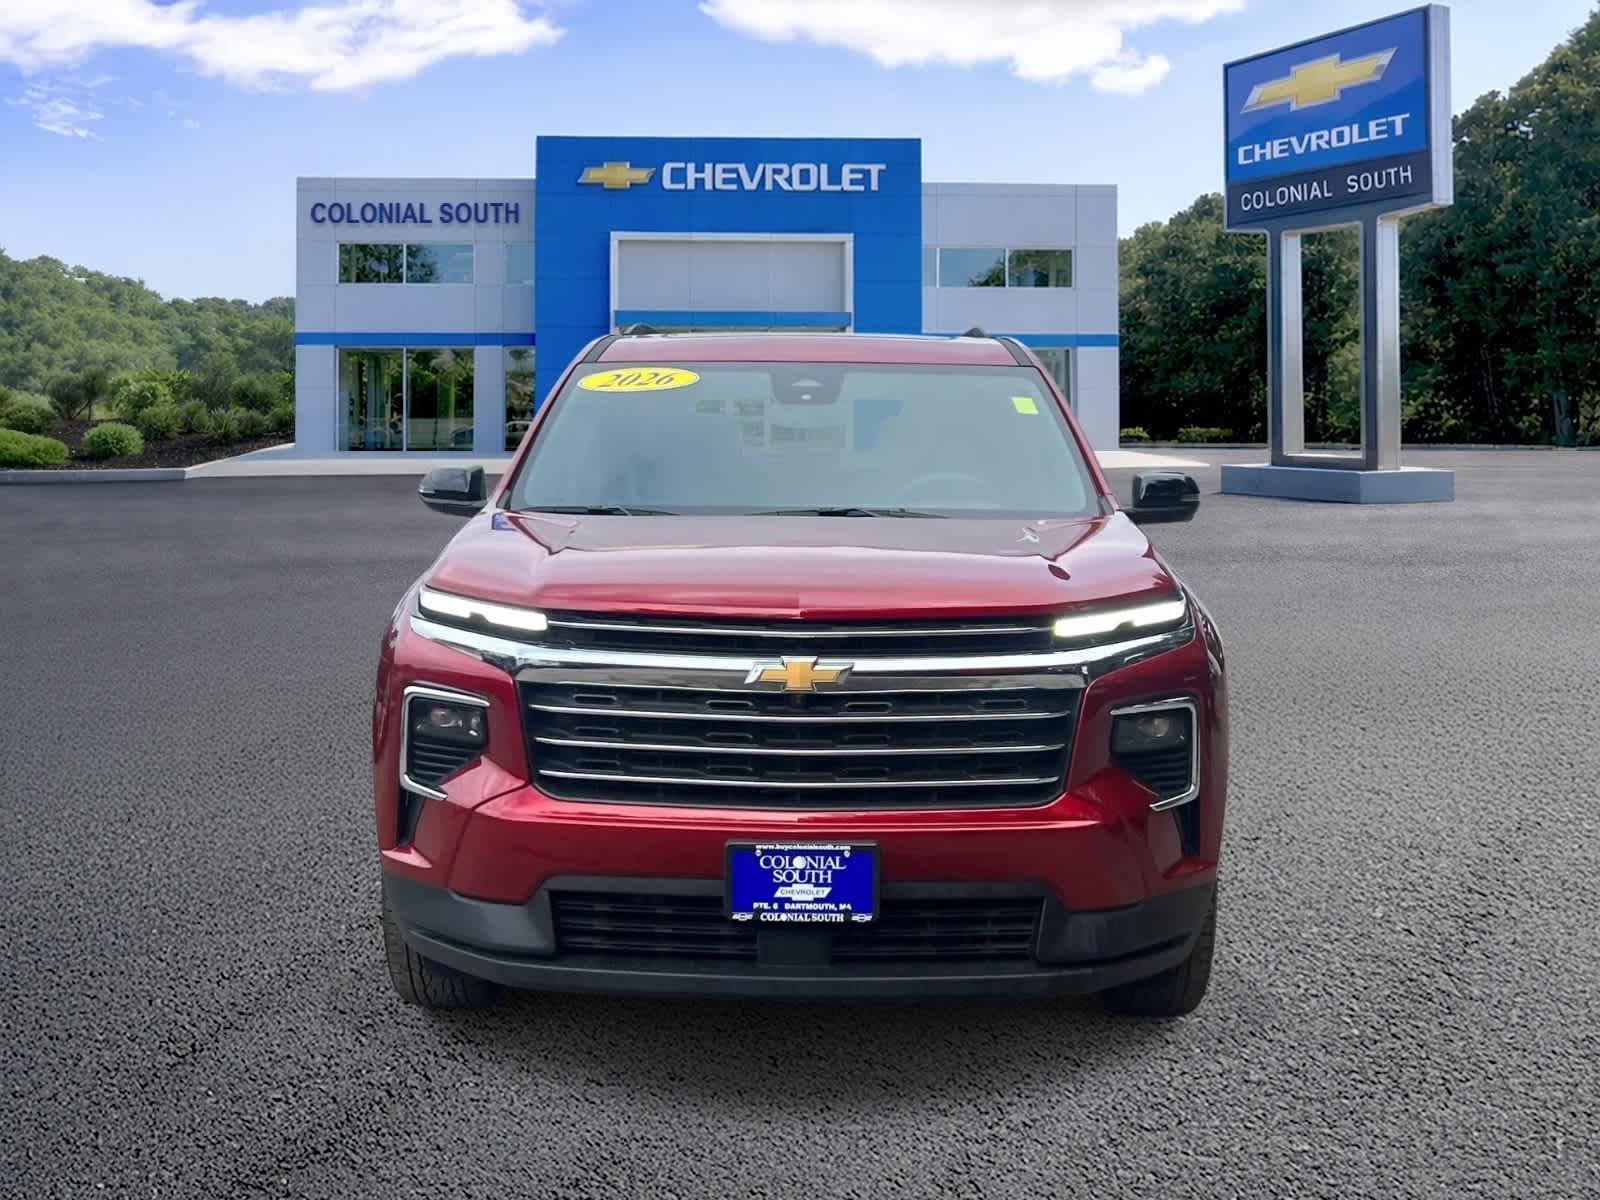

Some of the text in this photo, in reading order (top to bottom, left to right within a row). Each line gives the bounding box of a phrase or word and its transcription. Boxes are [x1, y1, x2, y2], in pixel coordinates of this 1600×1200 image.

[1238, 113, 1410, 165] CHEVROLET
[662, 162, 887, 191] CHEVROLET
[1241, 165, 1412, 211] COLONIAL SOUTH
[310, 202, 520, 223] COLONIAL SOUTH
[597, 372, 676, 387] 2026
[760, 855, 847, 869] COLONIAL
[773, 870, 832, 883] SOUTH
[760, 912, 844, 922] COLONIAL SOUTH
